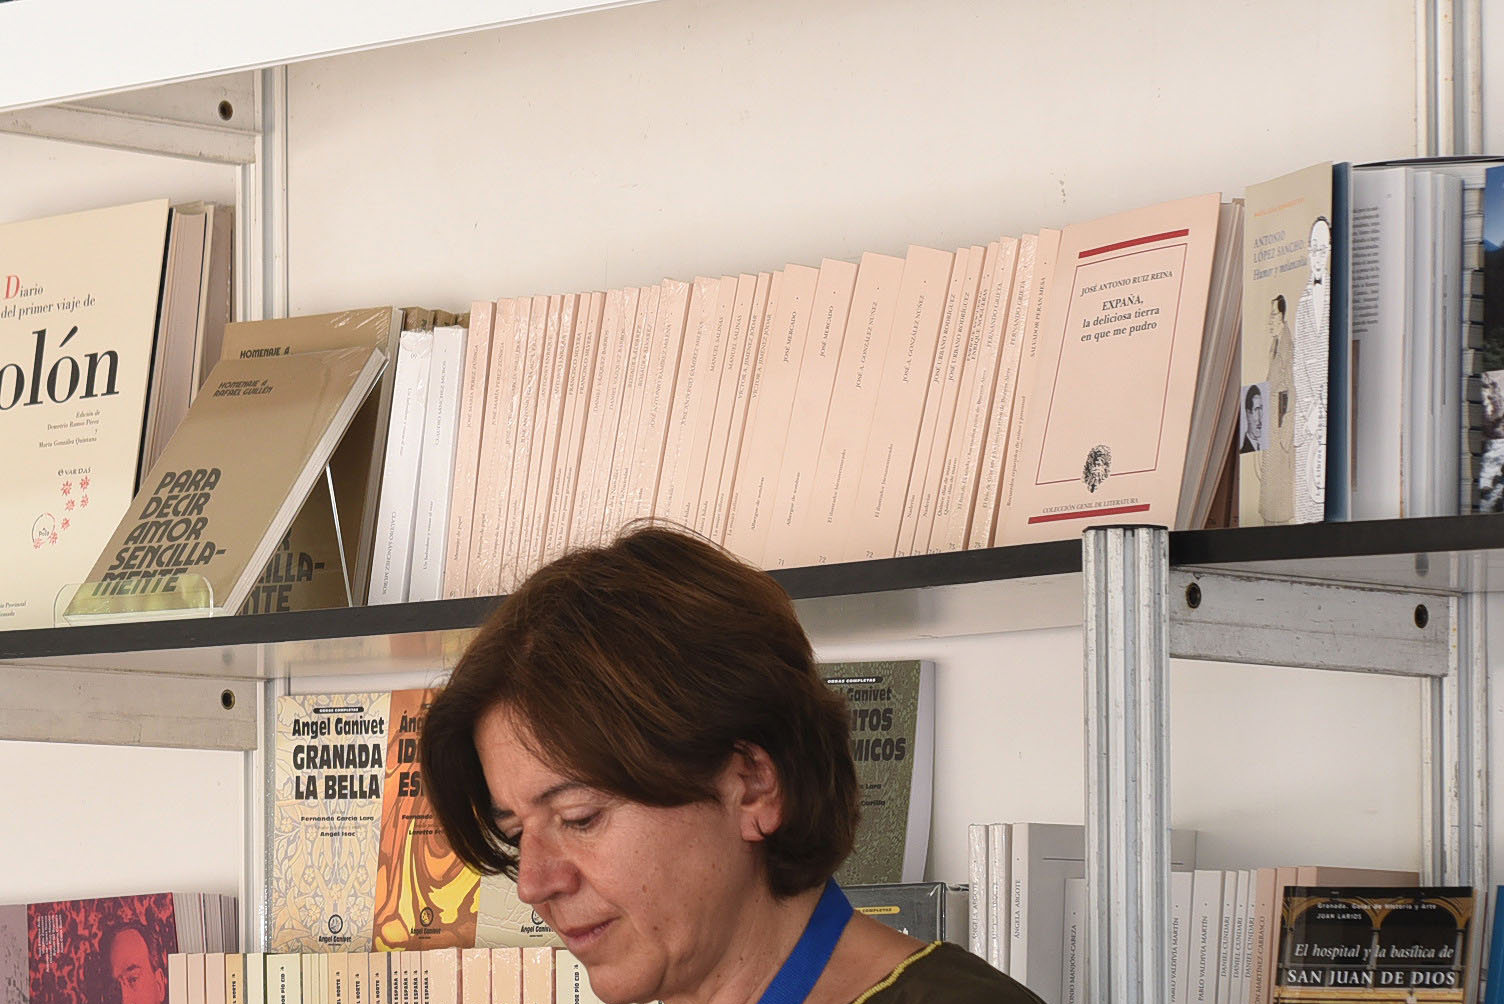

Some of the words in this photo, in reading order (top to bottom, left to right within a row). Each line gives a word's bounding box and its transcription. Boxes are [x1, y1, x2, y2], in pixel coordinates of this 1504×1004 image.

[4, 274, 44, 299] Diario
[1098, 279, 1132, 292] ANTONIO
[1132, 274, 1150, 285] RUIZ
[1150, 270, 1174, 281] REINA
[1, 305, 16, 319] del
[18, 303, 54, 320] primer
[57, 297, 81, 313] viaje
[83, 294, 96, 307] de
[1030, 325, 1041, 358] SALVADOR
[1037, 276, 1046, 297] MESA
[1082, 318, 1091, 328] la
[1092, 312, 1132, 326] deliciosa
[1134, 307, 1160, 319] tierra
[785, 311, 797, 346] MERCADO
[822, 305, 834, 340] MERCADO
[1080, 333, 1092, 342] en
[1094, 330, 1111, 342] que
[1112, 327, 1127, 336] me
[1129, 320, 1158, 336] pudro
[240, 346, 282, 360] HOMENAJE
[936, 335, 948, 367] URBANO
[951, 332, 963, 364] URBANO
[154, 468, 222, 496] PARA
[138, 492, 211, 520] DECIR
[123, 517, 208, 546] AMOR
[107, 541, 227, 571] SENCILLA-
[334, 715, 385, 736] Ganivet
[292, 743, 383, 771] GRANADA
[295, 775, 318, 800] LA
[324, 774, 381, 800] BELLA
[332, 935, 352, 943] Ganivet
[424, 927, 441, 935] Ganivet
[1294, 943, 1309, 957] El
[1312, 944, 1361, 961] hospital
[1363, 947, 1372, 962] y
[1374, 944, 1387, 958] la
[1390, 944, 1436, 958] basílica
[1438, 944, 1455, 958] de
[1287, 969, 1323, 984] SAN
[1328, 970, 1374, 985] JUAN
[1380, 971, 1405, 985] DE
[1411, 971, 1456, 985] DIOS
